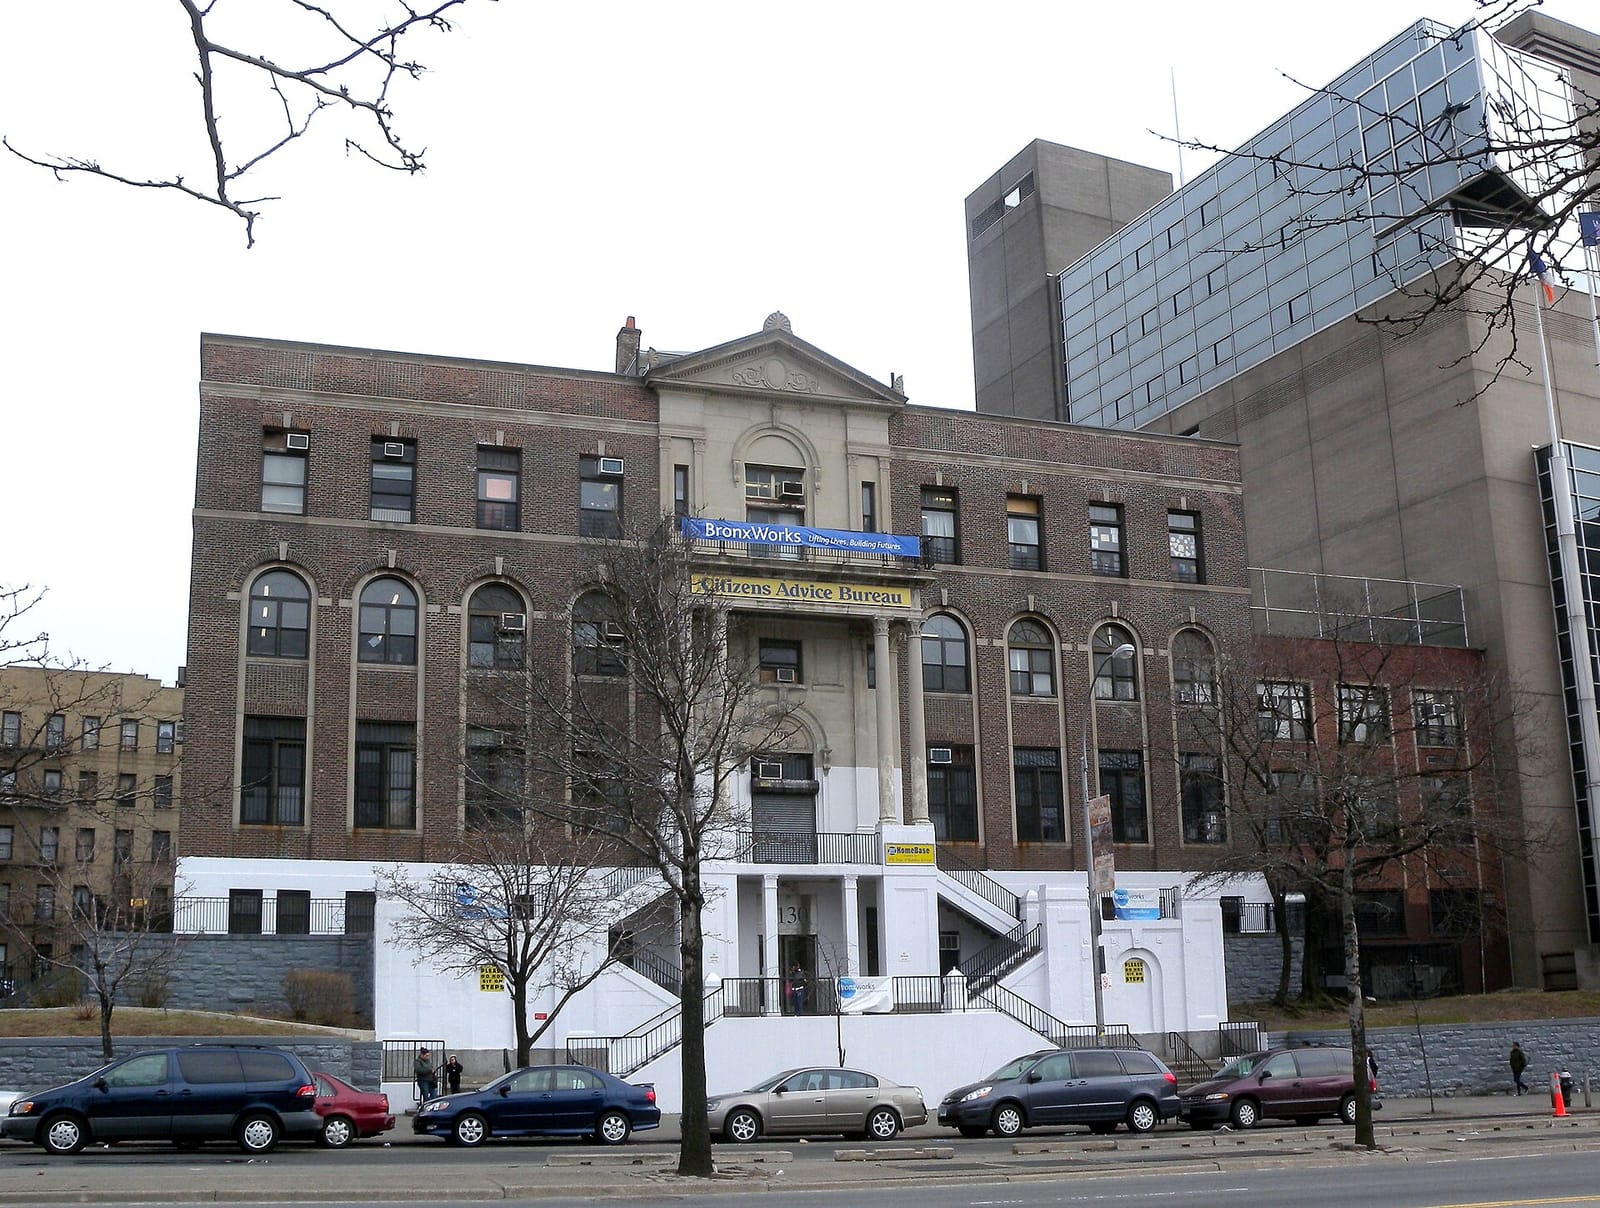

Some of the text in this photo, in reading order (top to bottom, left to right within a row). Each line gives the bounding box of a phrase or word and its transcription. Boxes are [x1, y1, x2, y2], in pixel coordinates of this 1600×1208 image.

[705, 522, 802, 543] BronxWorks
[808, 534, 830, 545] Lifting
[850, 539, 877, 549] Building
[877, 541, 901, 550] Futures
[701, 577, 903, 604] Citizens Advice Bureau
[896, 846, 930, 854] HomeBase
[780, 906, 808, 923] 130
